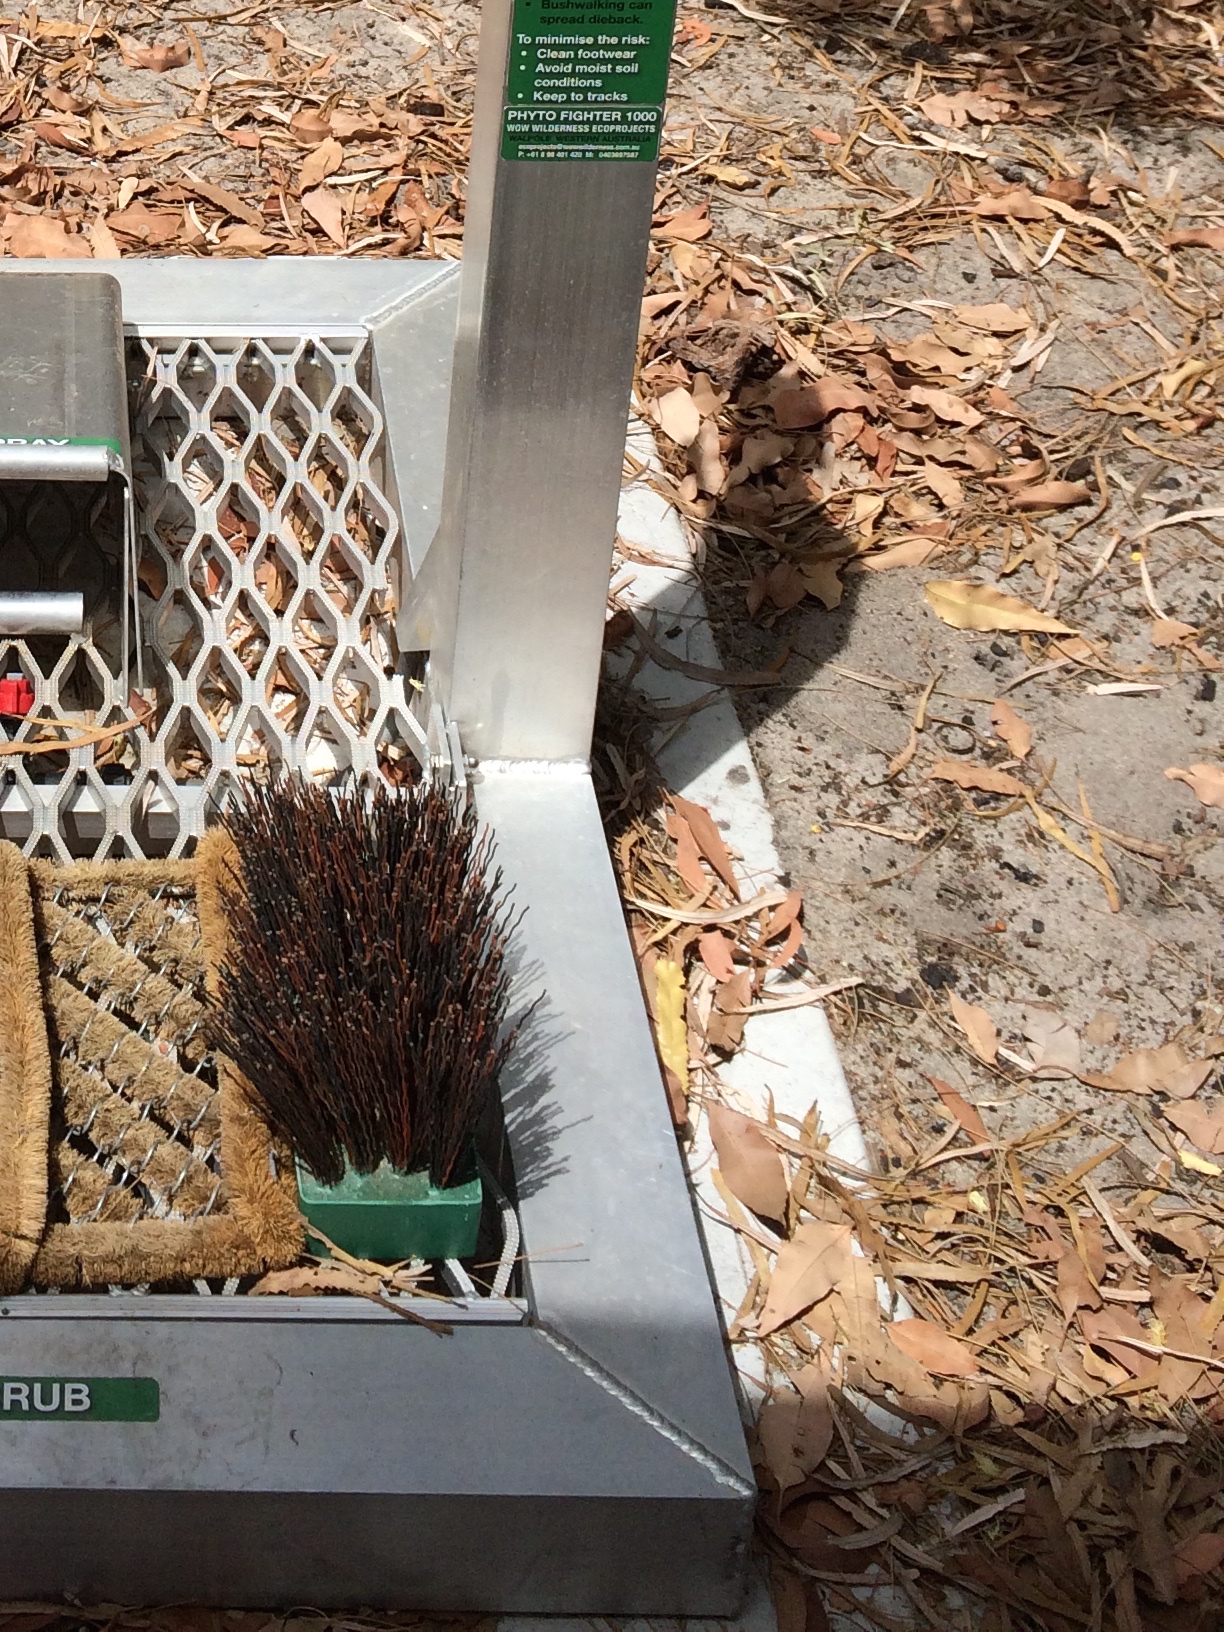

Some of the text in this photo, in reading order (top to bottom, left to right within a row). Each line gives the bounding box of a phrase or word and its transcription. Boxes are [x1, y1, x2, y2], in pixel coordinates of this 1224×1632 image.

[541, 0, 652, 10] Bushwalking can
[540, 15, 643, 25] spread dieback.
[517, 34, 650, 45] To minimise the risk:
[537, 49, 637, 59] Clean footwear
[536, 63, 638, 73] Avoid moist soil
[534, 77, 602, 87] conditions
[534, 92, 628, 103] Keep to tracks
[508, 111, 657, 121] PHYTO FIGHTER 1000
[532, 124, 589, 132] WILDERNESS
